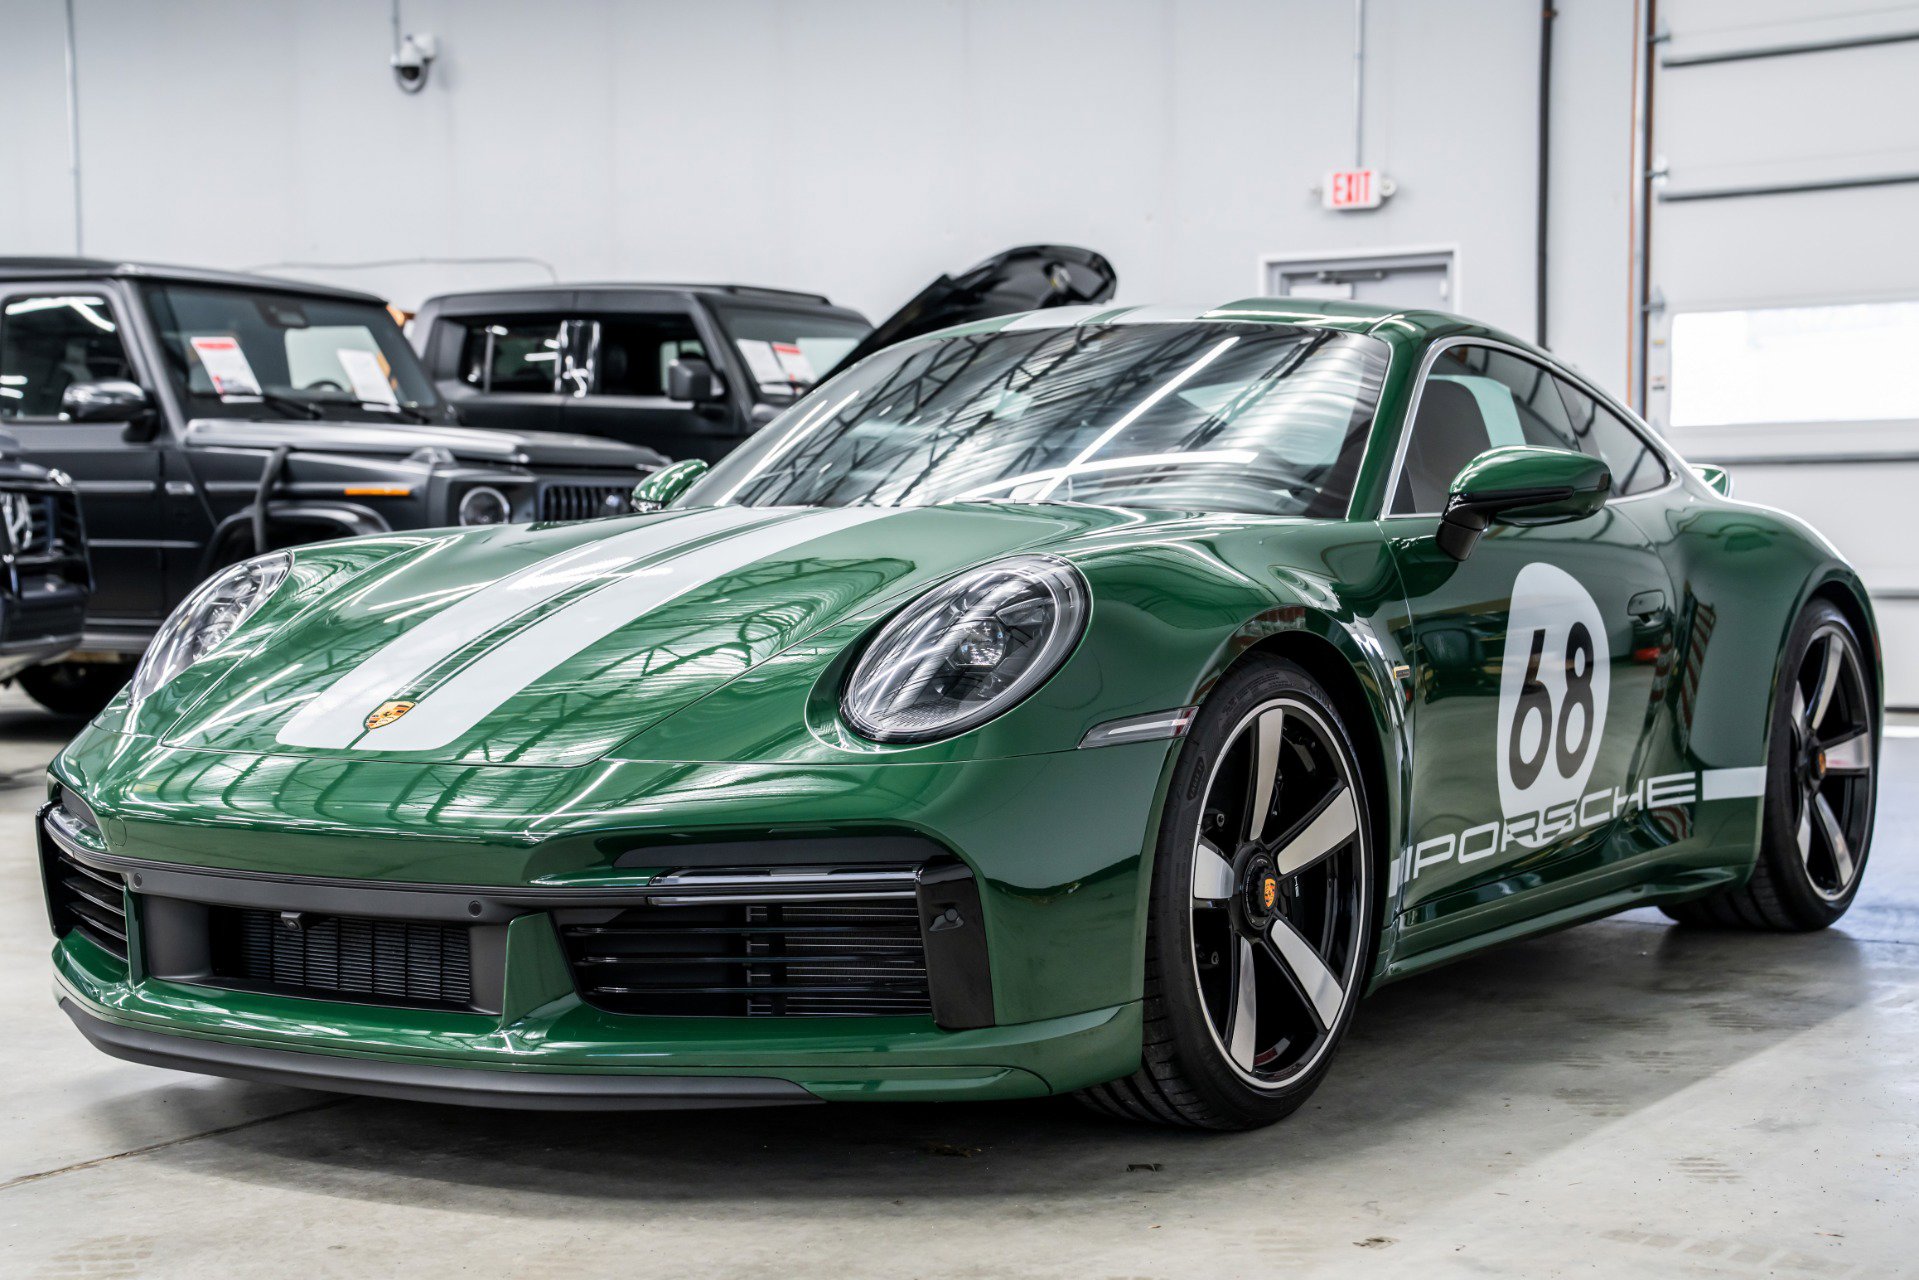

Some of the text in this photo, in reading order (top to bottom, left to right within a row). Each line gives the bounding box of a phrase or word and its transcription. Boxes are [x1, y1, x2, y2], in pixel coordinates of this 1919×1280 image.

[1333, 172, 1370, 204] EXIT
[1509, 621, 1594, 790] 68
[1413, 771, 1696, 880] PORSCHE
